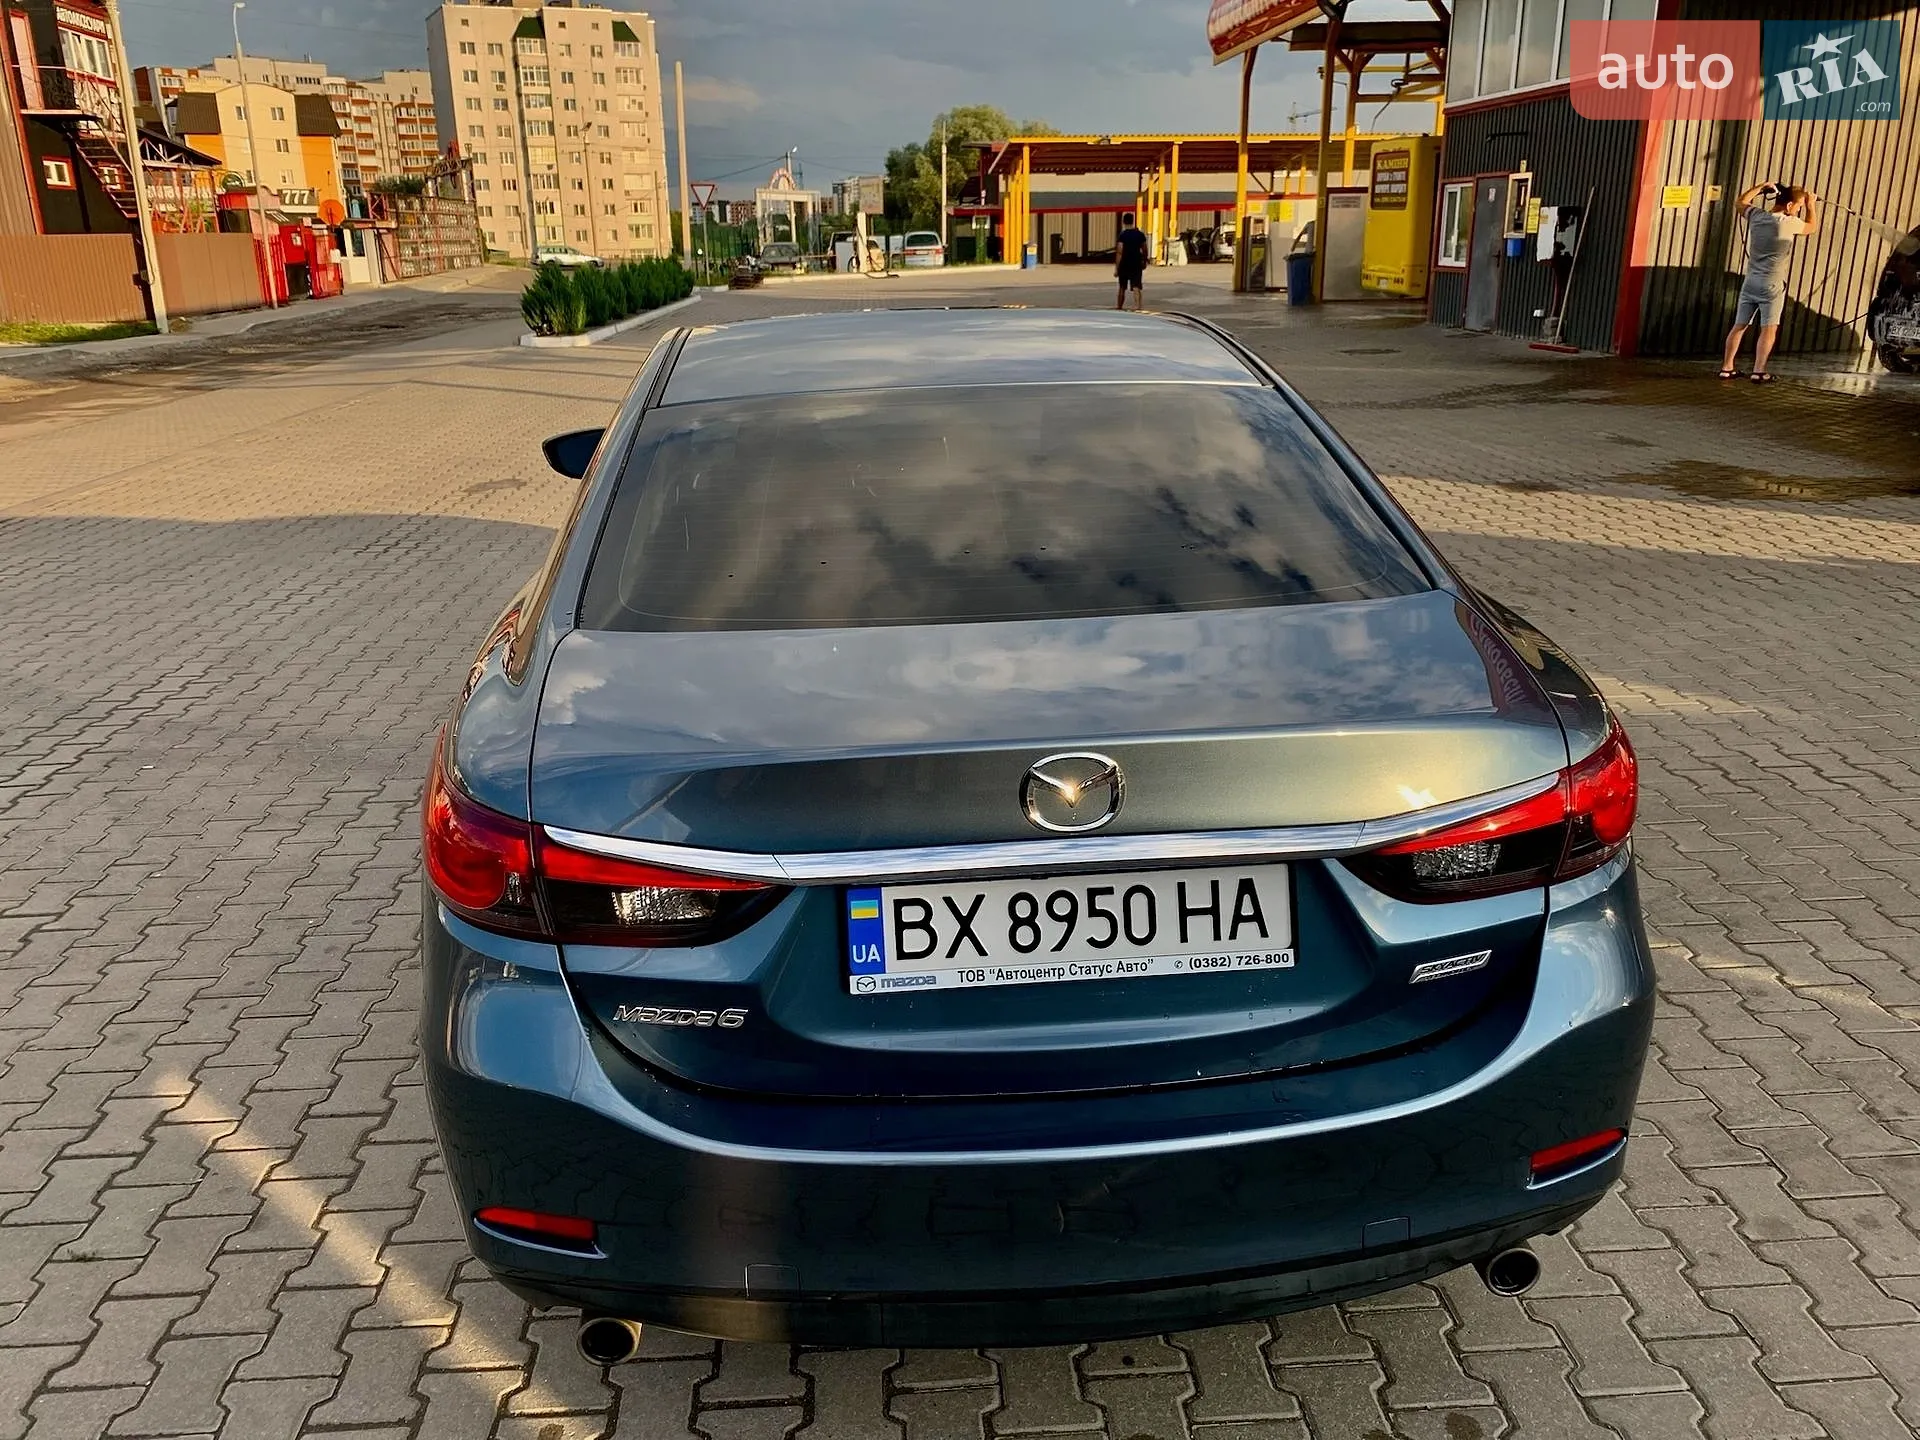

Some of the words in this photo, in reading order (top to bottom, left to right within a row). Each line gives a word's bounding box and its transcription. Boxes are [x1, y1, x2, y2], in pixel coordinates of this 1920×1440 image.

[282, 189, 309, 204] 777
[893, 893, 989, 961] BX
[1007, 884, 1157, 954] 8950
[1176, 877, 1269, 943] HA
[852, 945, 881, 964] UA
[1189, 954, 1232, 971] (0382)
[1236, 952, 1290, 967] 726-800
[881, 975, 937, 989] mazda
[957, 969, 985, 983] ТОВ
[1068, 962, 1113, 977] Статус
